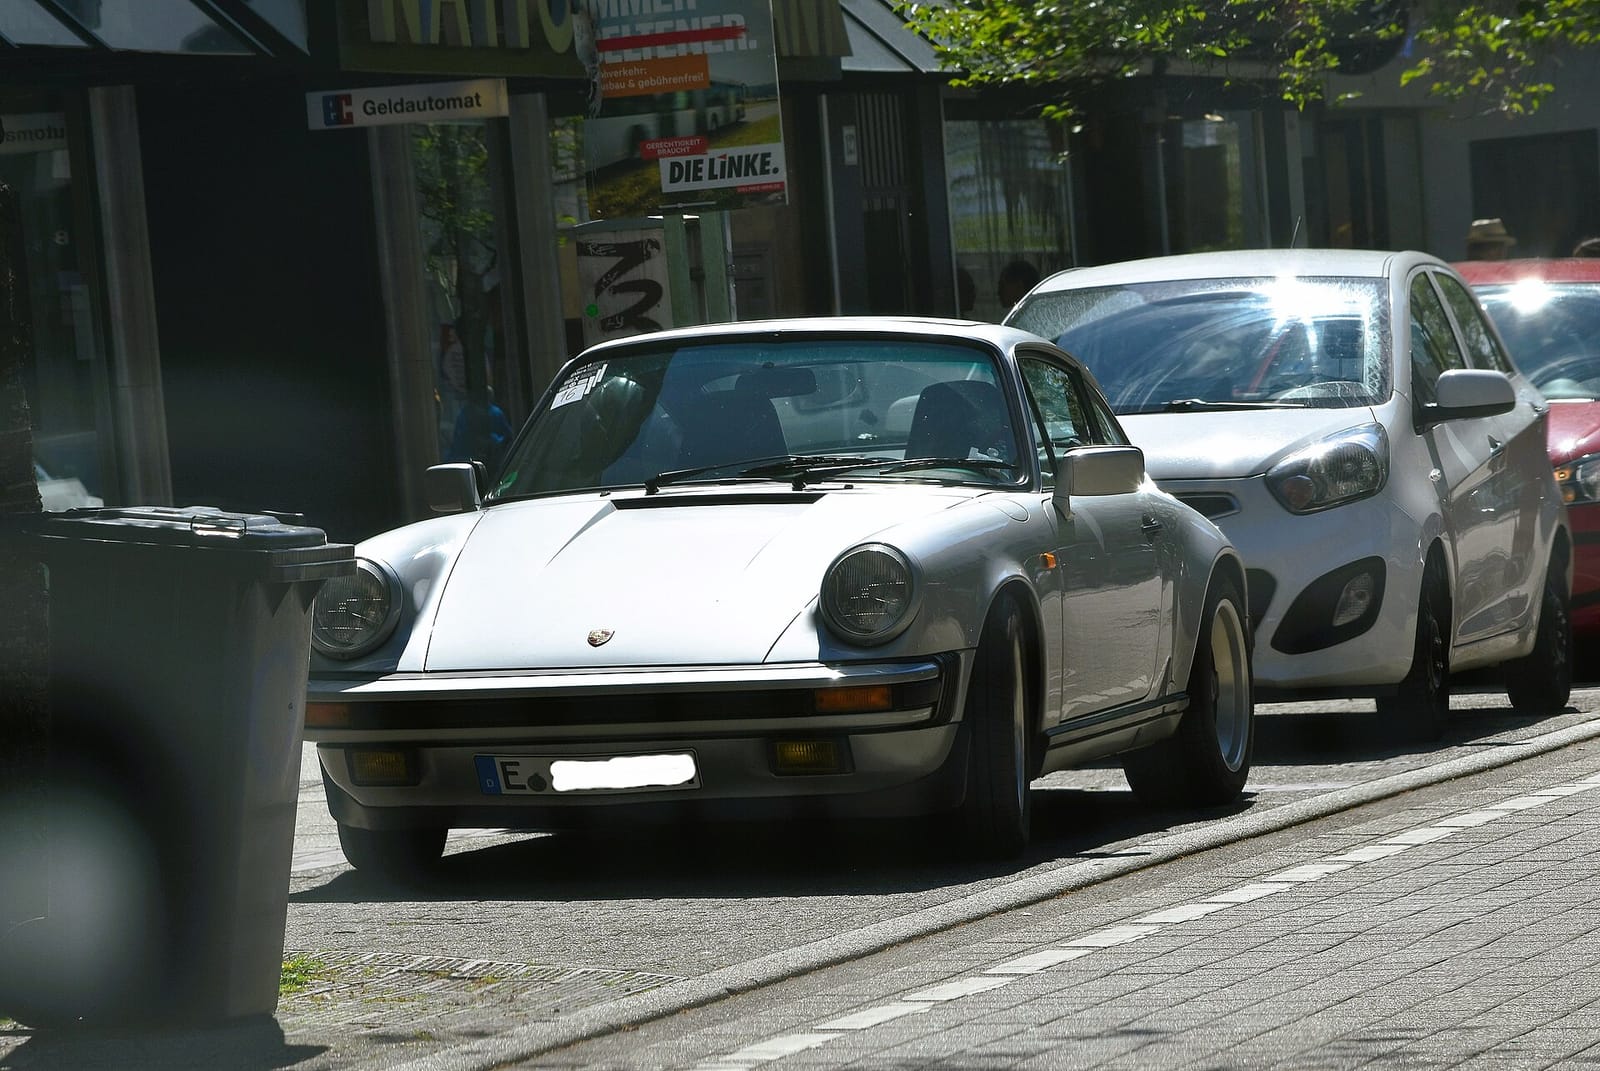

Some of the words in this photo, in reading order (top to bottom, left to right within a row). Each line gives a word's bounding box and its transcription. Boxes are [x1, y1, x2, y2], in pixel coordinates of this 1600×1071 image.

[597, 14, 757, 63] ELTENER.
[628, 80, 635, 88] &
[362, 92, 482, 116] Geldautomat
[646, 138, 700, 150] GERECHTIGKEIT
[657, 146, 690, 156] BRAUCHT
[669, 159, 704, 184] DIE
